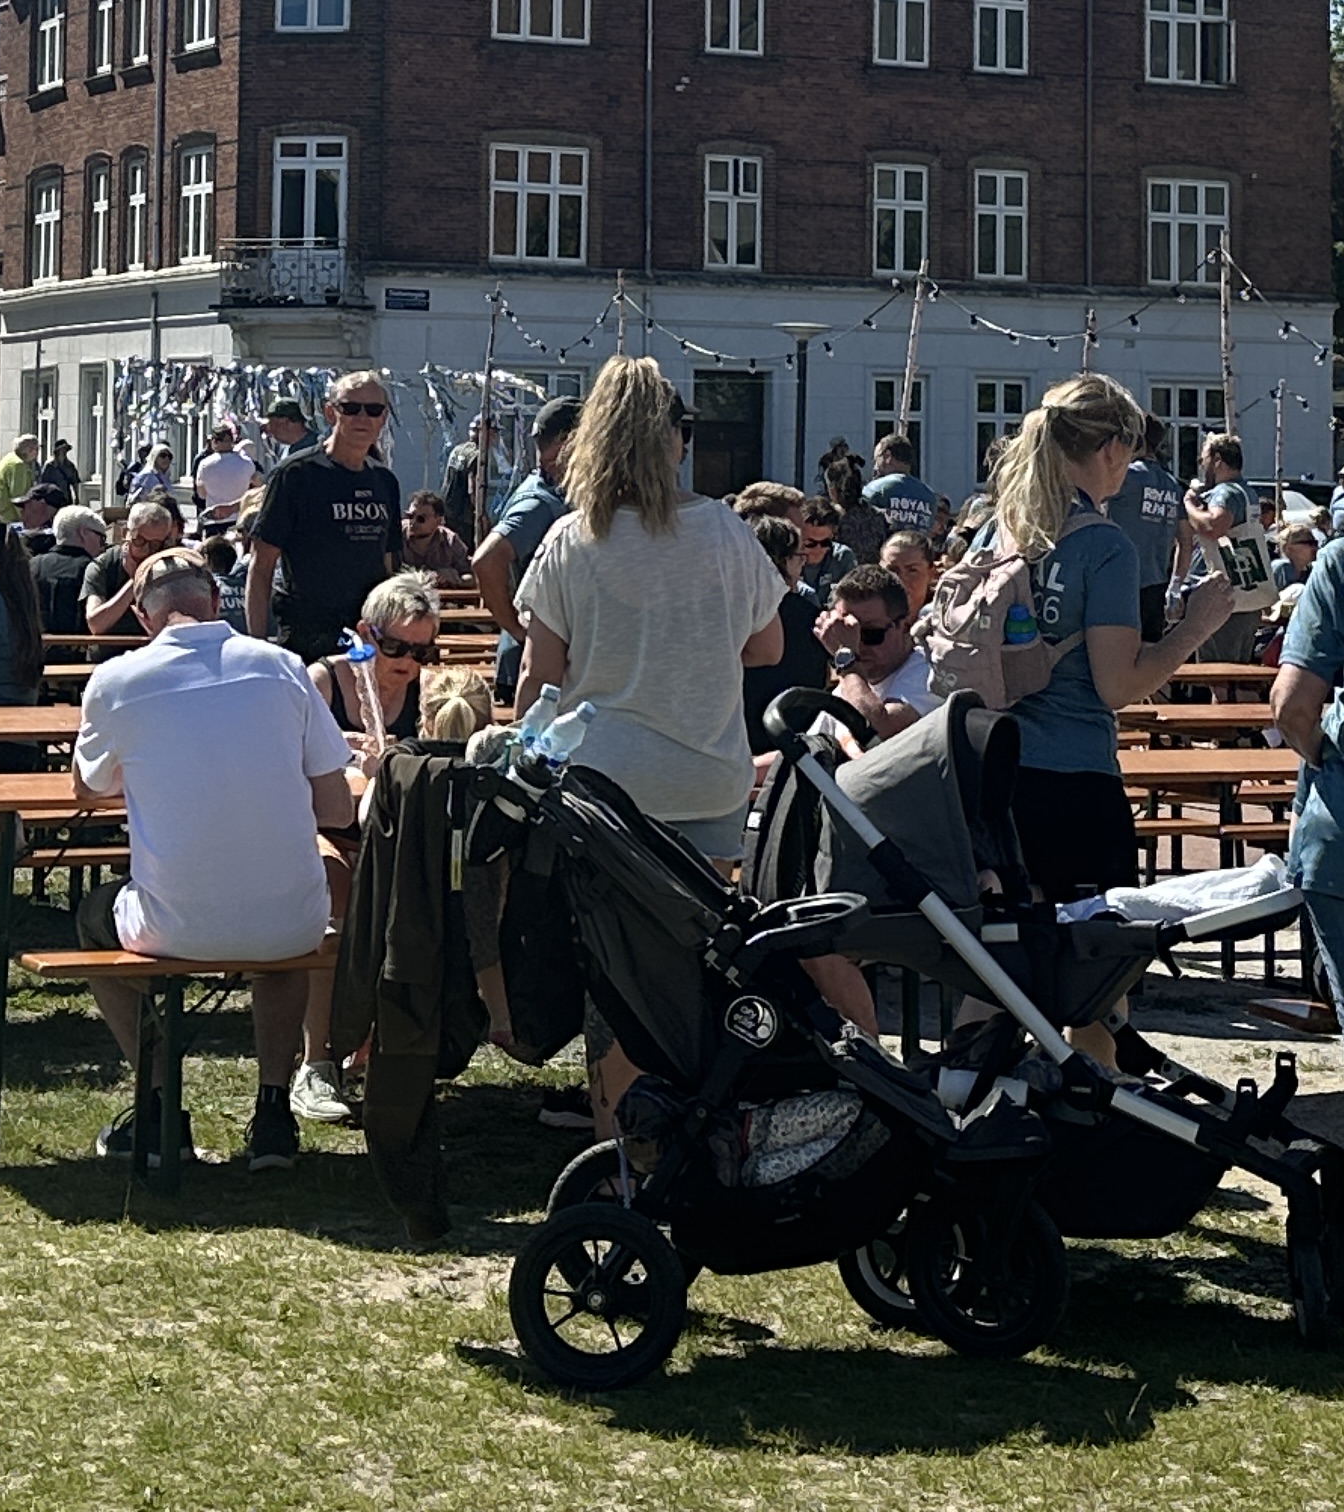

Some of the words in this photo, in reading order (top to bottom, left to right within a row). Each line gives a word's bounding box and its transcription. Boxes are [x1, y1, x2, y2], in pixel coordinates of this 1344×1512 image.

[1143, 486, 1179, 504] ROYAL
[332, 502, 389, 520] BISON
[890, 497, 932, 516] ROYAL
